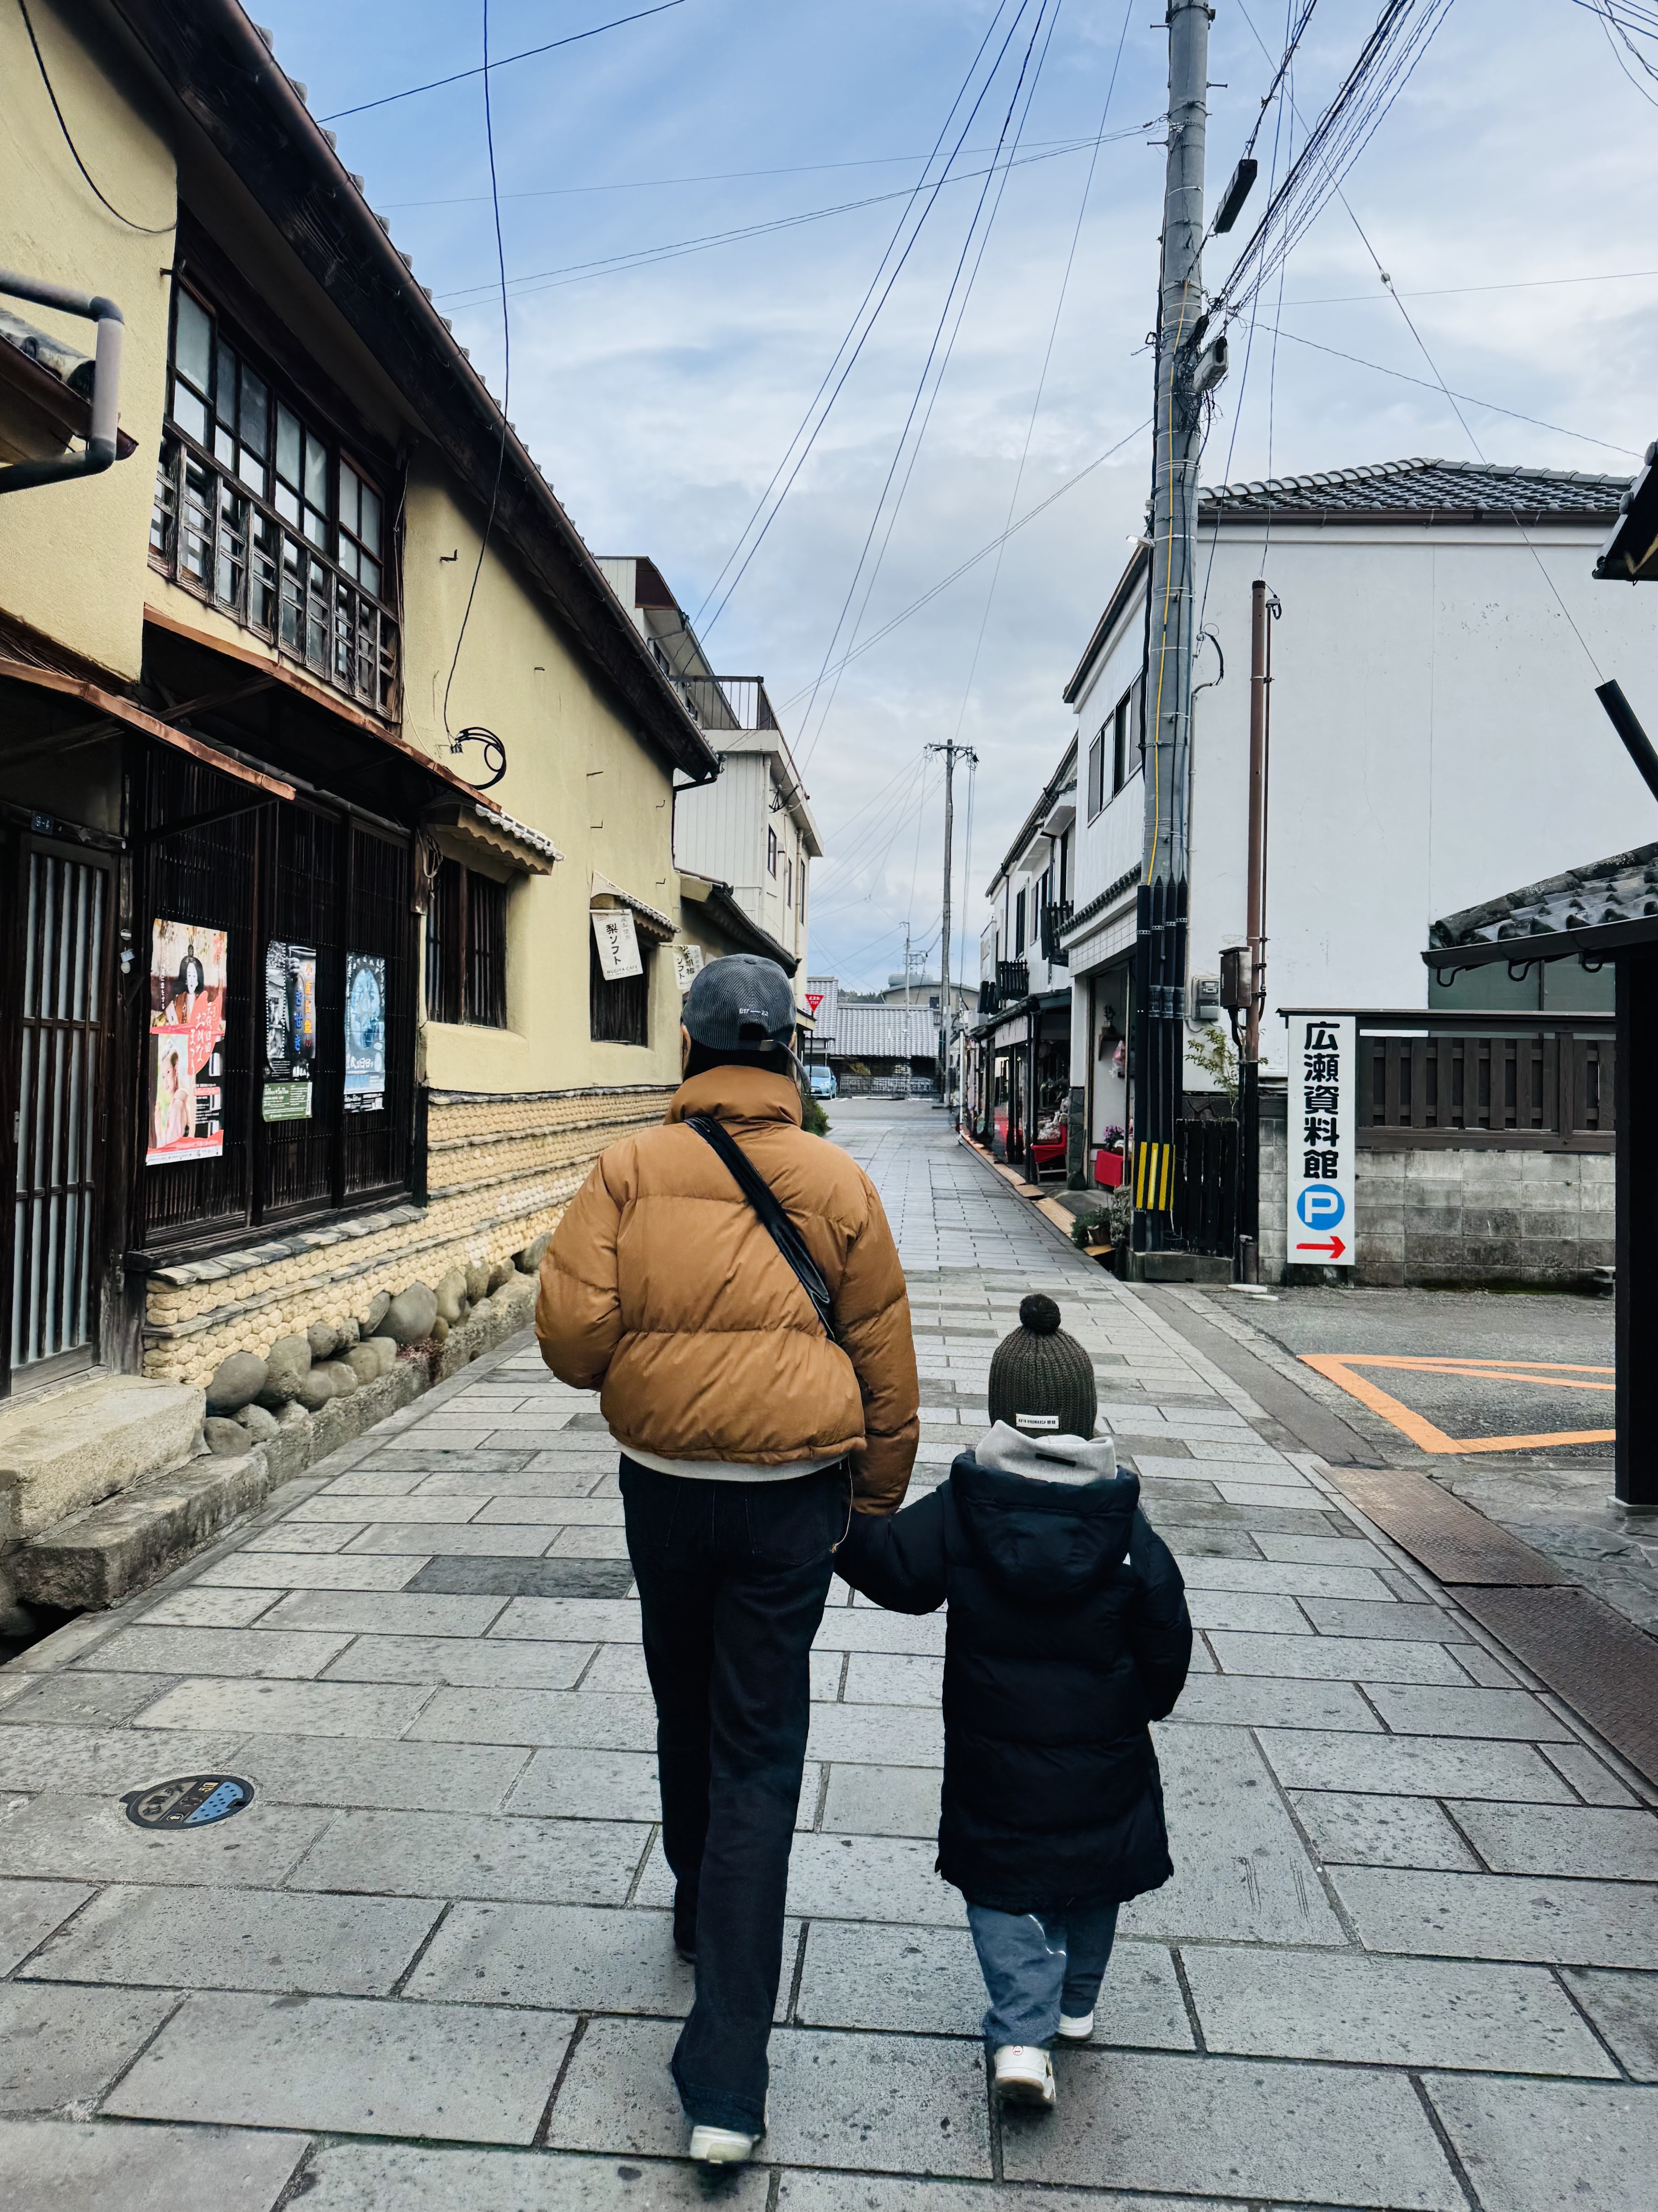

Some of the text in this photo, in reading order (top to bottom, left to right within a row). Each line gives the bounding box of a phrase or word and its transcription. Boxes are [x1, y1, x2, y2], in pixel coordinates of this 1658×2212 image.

[606, 923, 622, 965] 梨ソフト
[195, 1012, 206, 1062] おひな
[1304, 1022, 1340, 1179] 広瀬資料館
[1304, 1191, 1338, 1223] P
